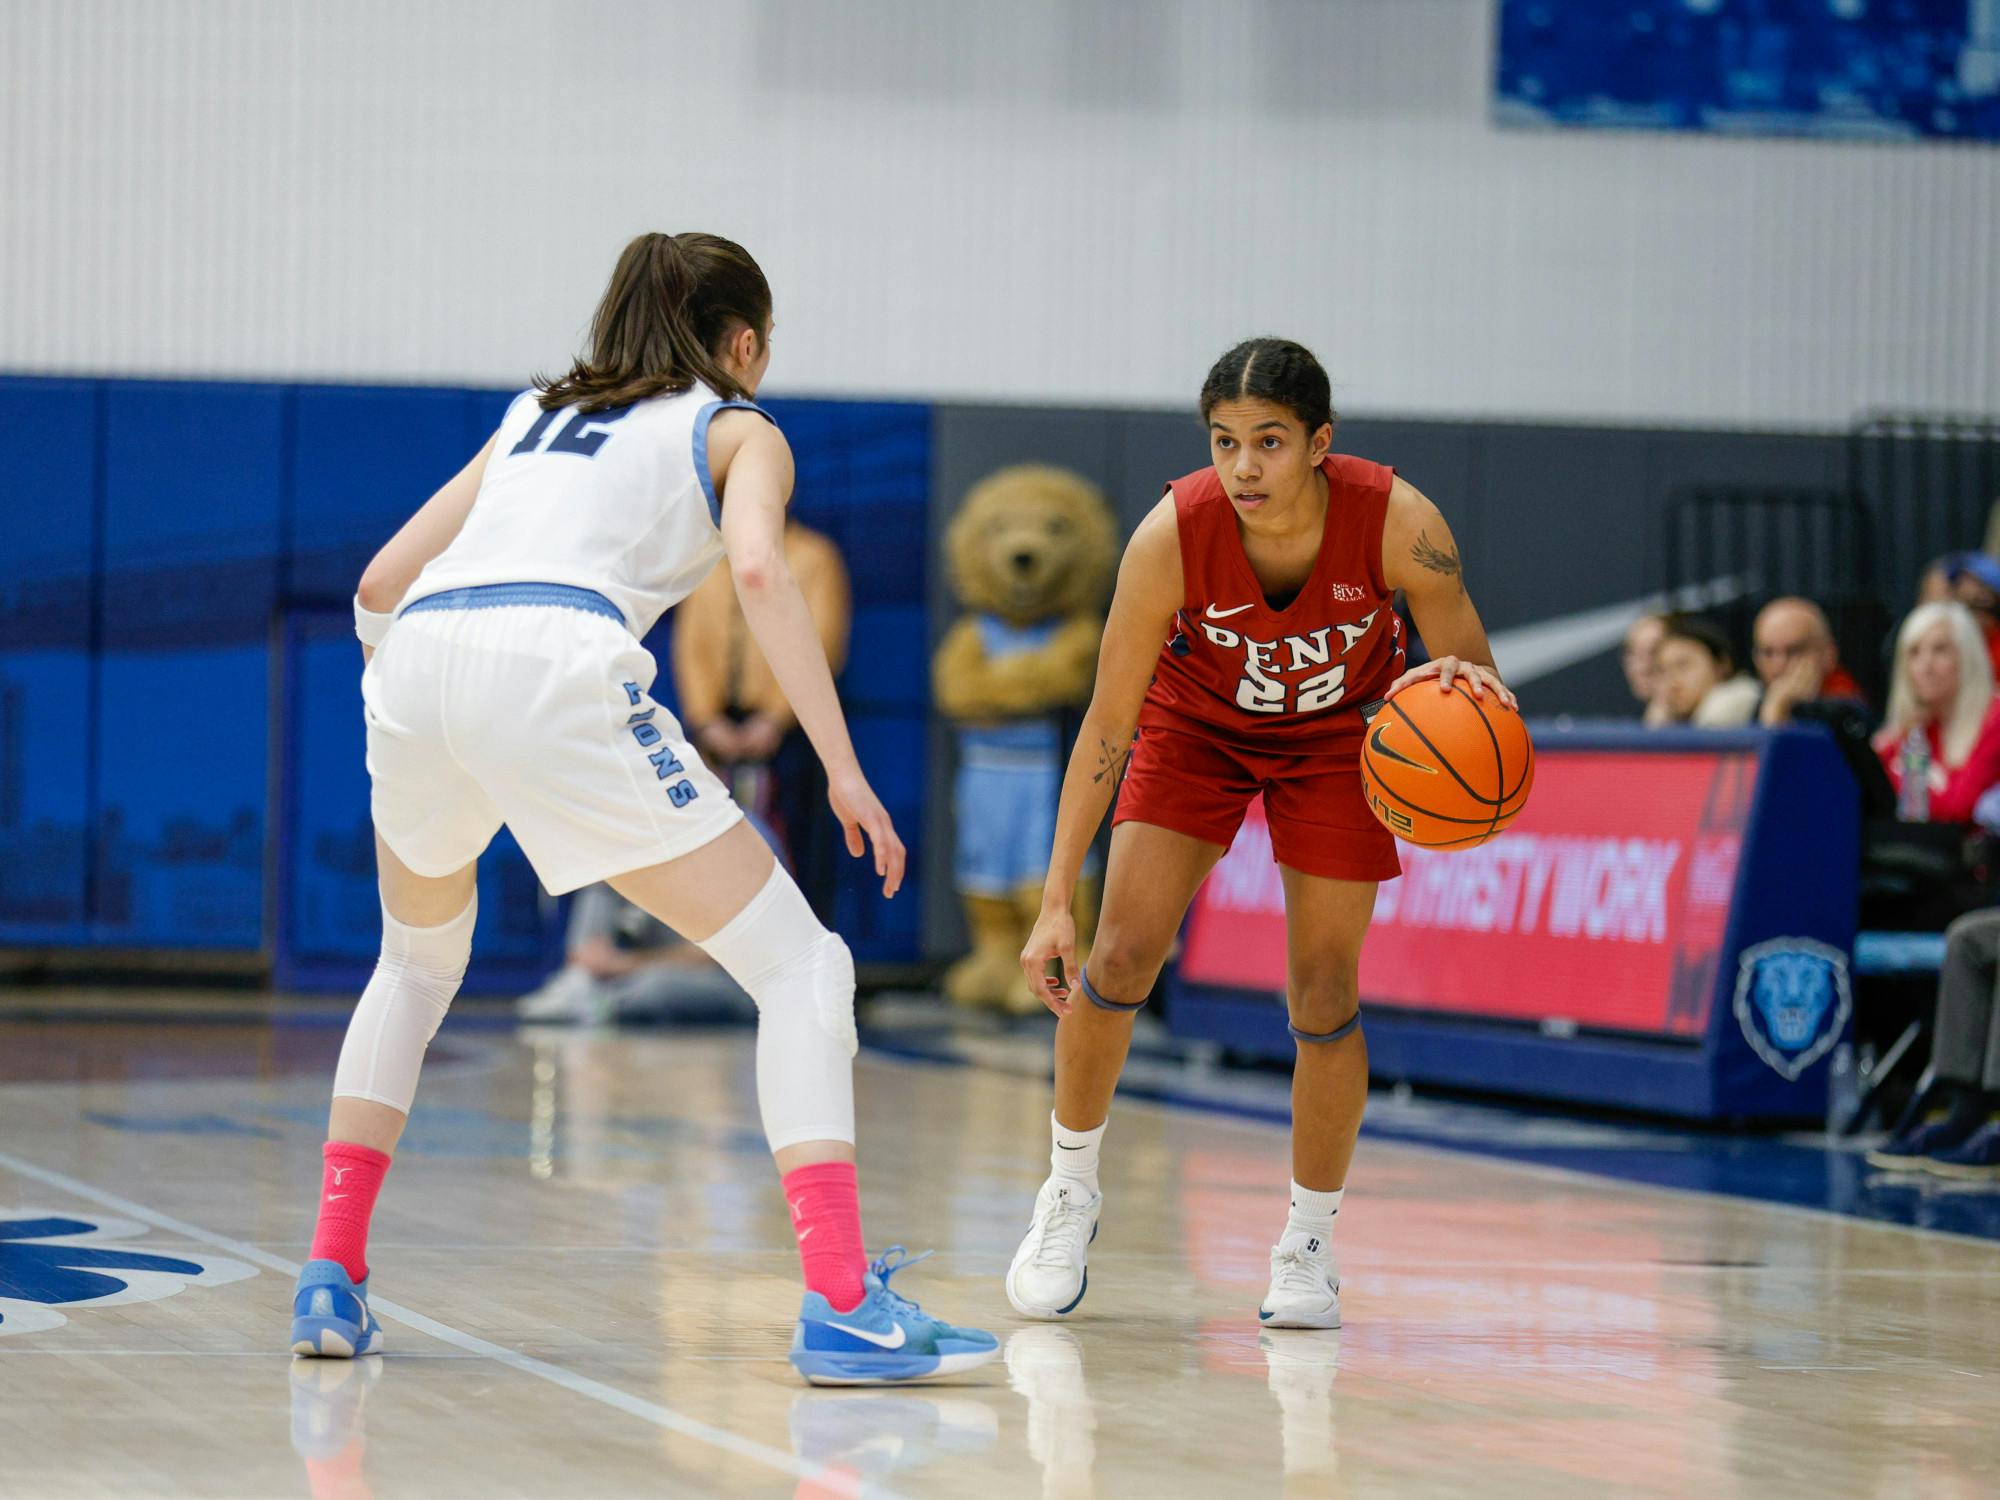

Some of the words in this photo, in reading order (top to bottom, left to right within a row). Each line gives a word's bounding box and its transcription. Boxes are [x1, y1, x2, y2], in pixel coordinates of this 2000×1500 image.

[507, 402, 641, 460] 12
[1341, 585, 1364, 598] IVY
[1235, 660, 1346, 714] 22
